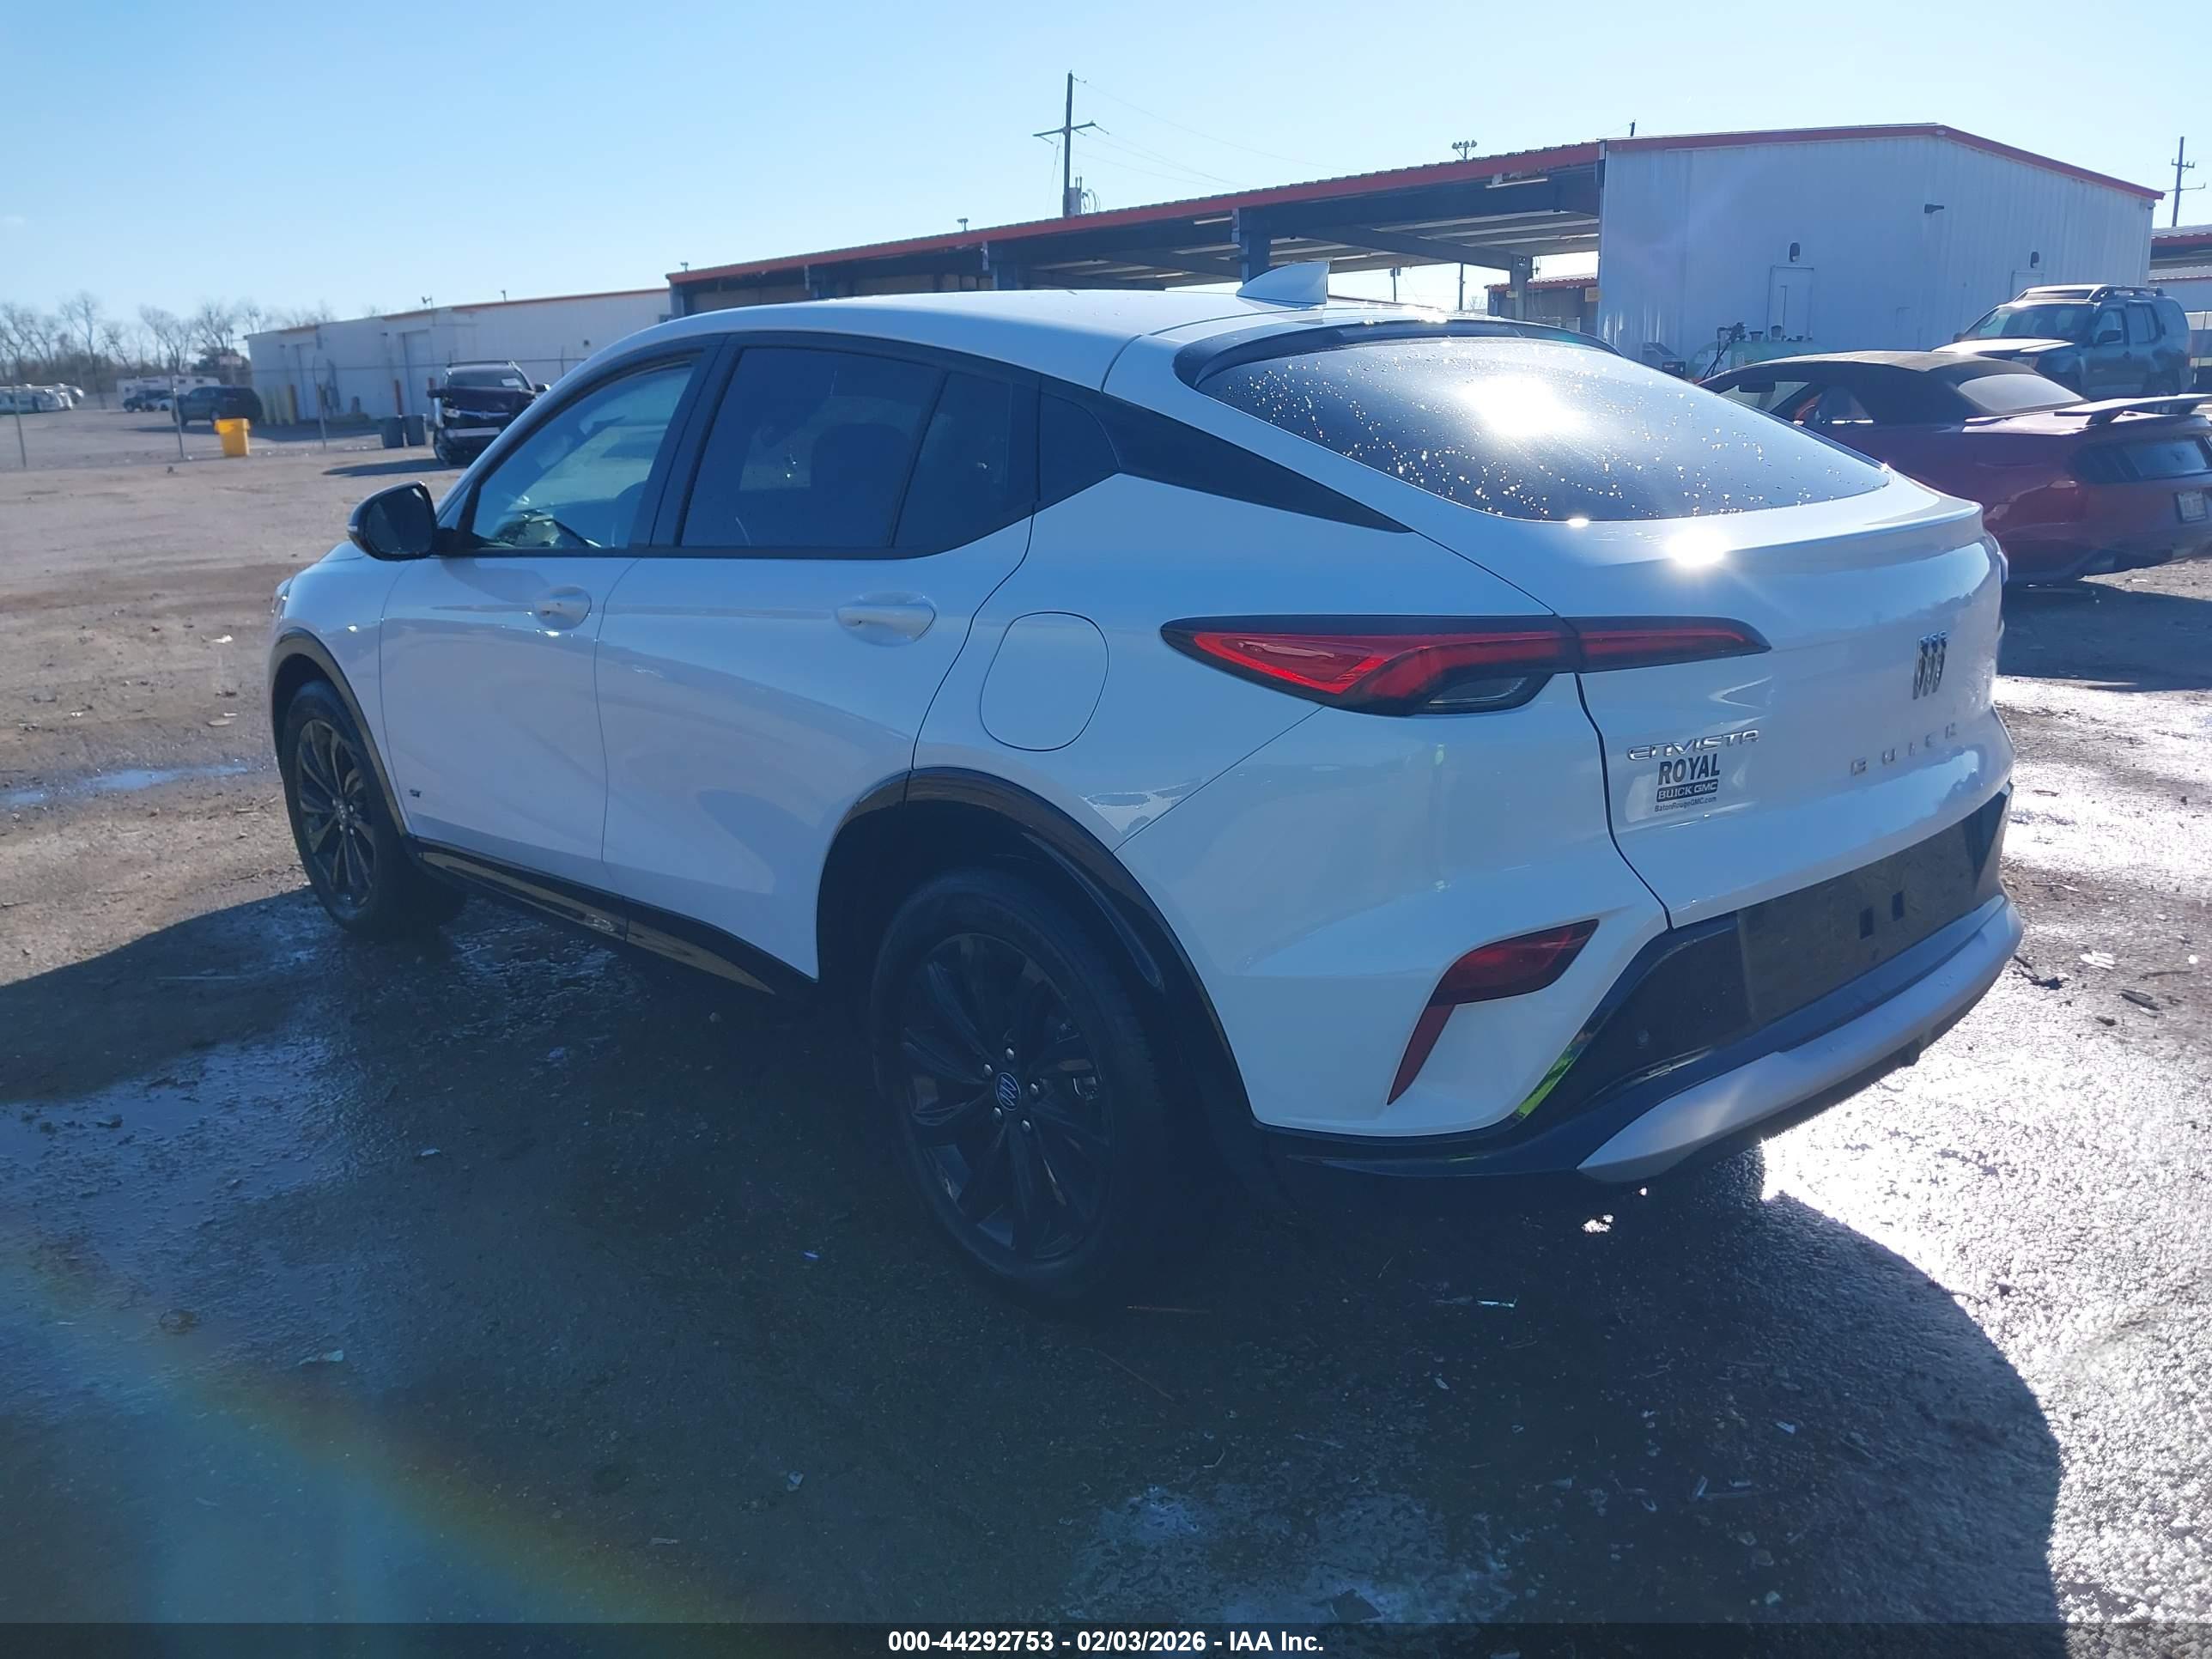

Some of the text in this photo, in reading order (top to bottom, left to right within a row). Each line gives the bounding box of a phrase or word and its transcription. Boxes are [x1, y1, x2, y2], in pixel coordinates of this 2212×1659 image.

[1628, 729, 1759, 761] ENVISTA
[1850, 722, 1957, 776] BUICK
[1657, 753, 1720, 785] ROYAL
[1655, 796, 1717, 812] BatonRougeGMC.com
[1658, 781, 1718, 799] BUICK GMC
